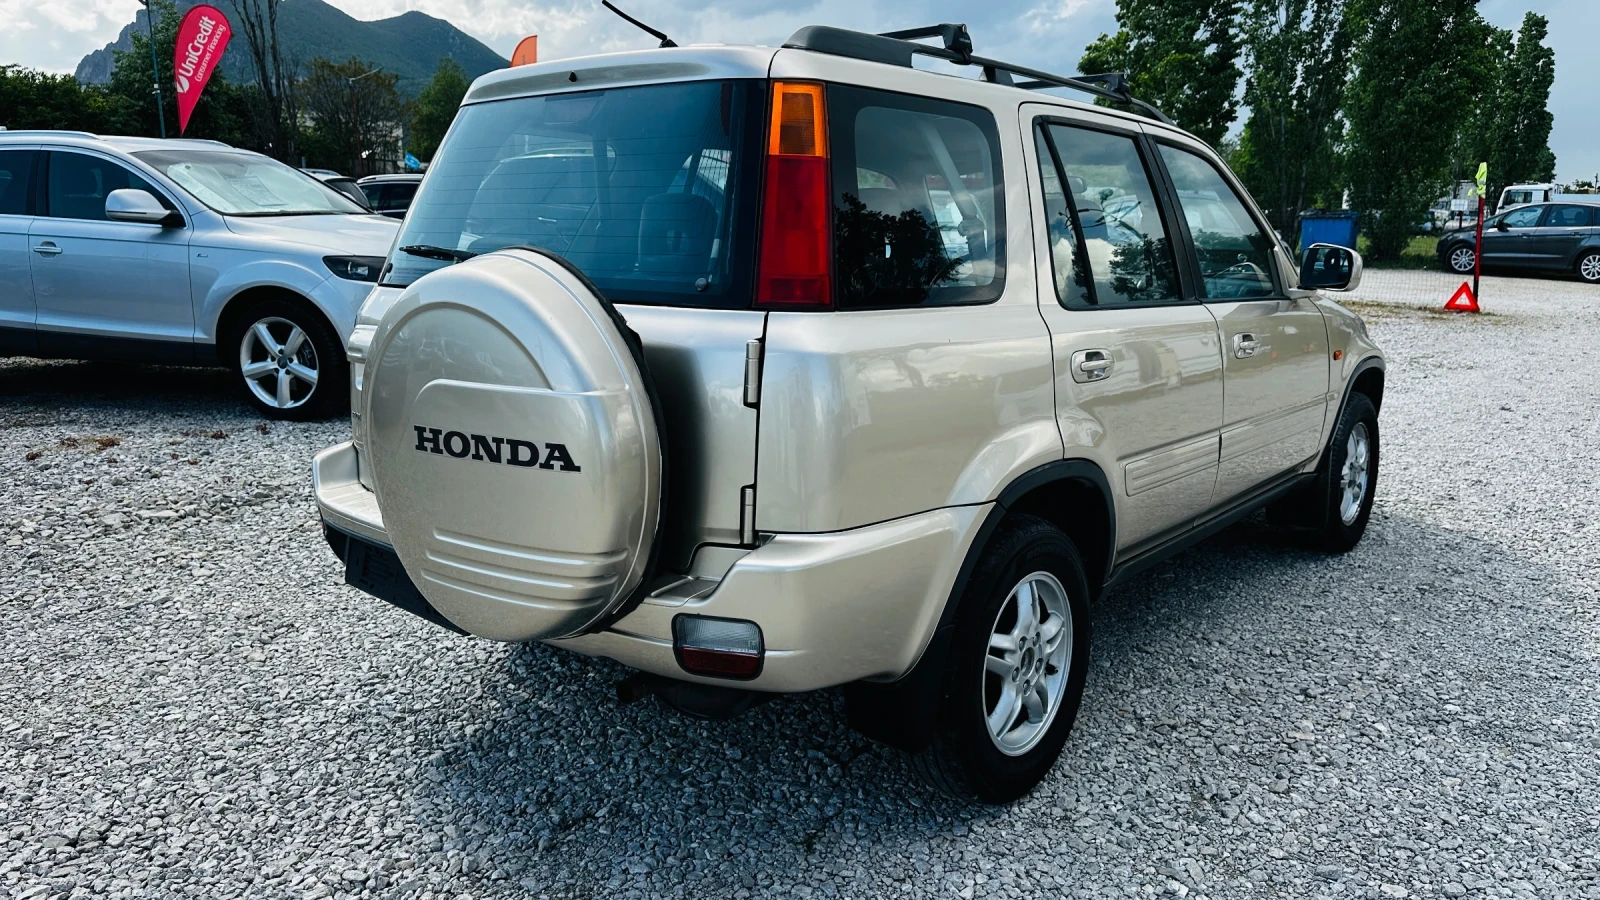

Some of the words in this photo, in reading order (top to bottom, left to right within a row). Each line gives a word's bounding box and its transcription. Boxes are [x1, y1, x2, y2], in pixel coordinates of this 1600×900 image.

[179, 16, 216, 77] UniCredit
[195, 50, 212, 82] Consumer
[207, 24, 227, 53] Financing
[413, 425, 582, 473] HONDA
